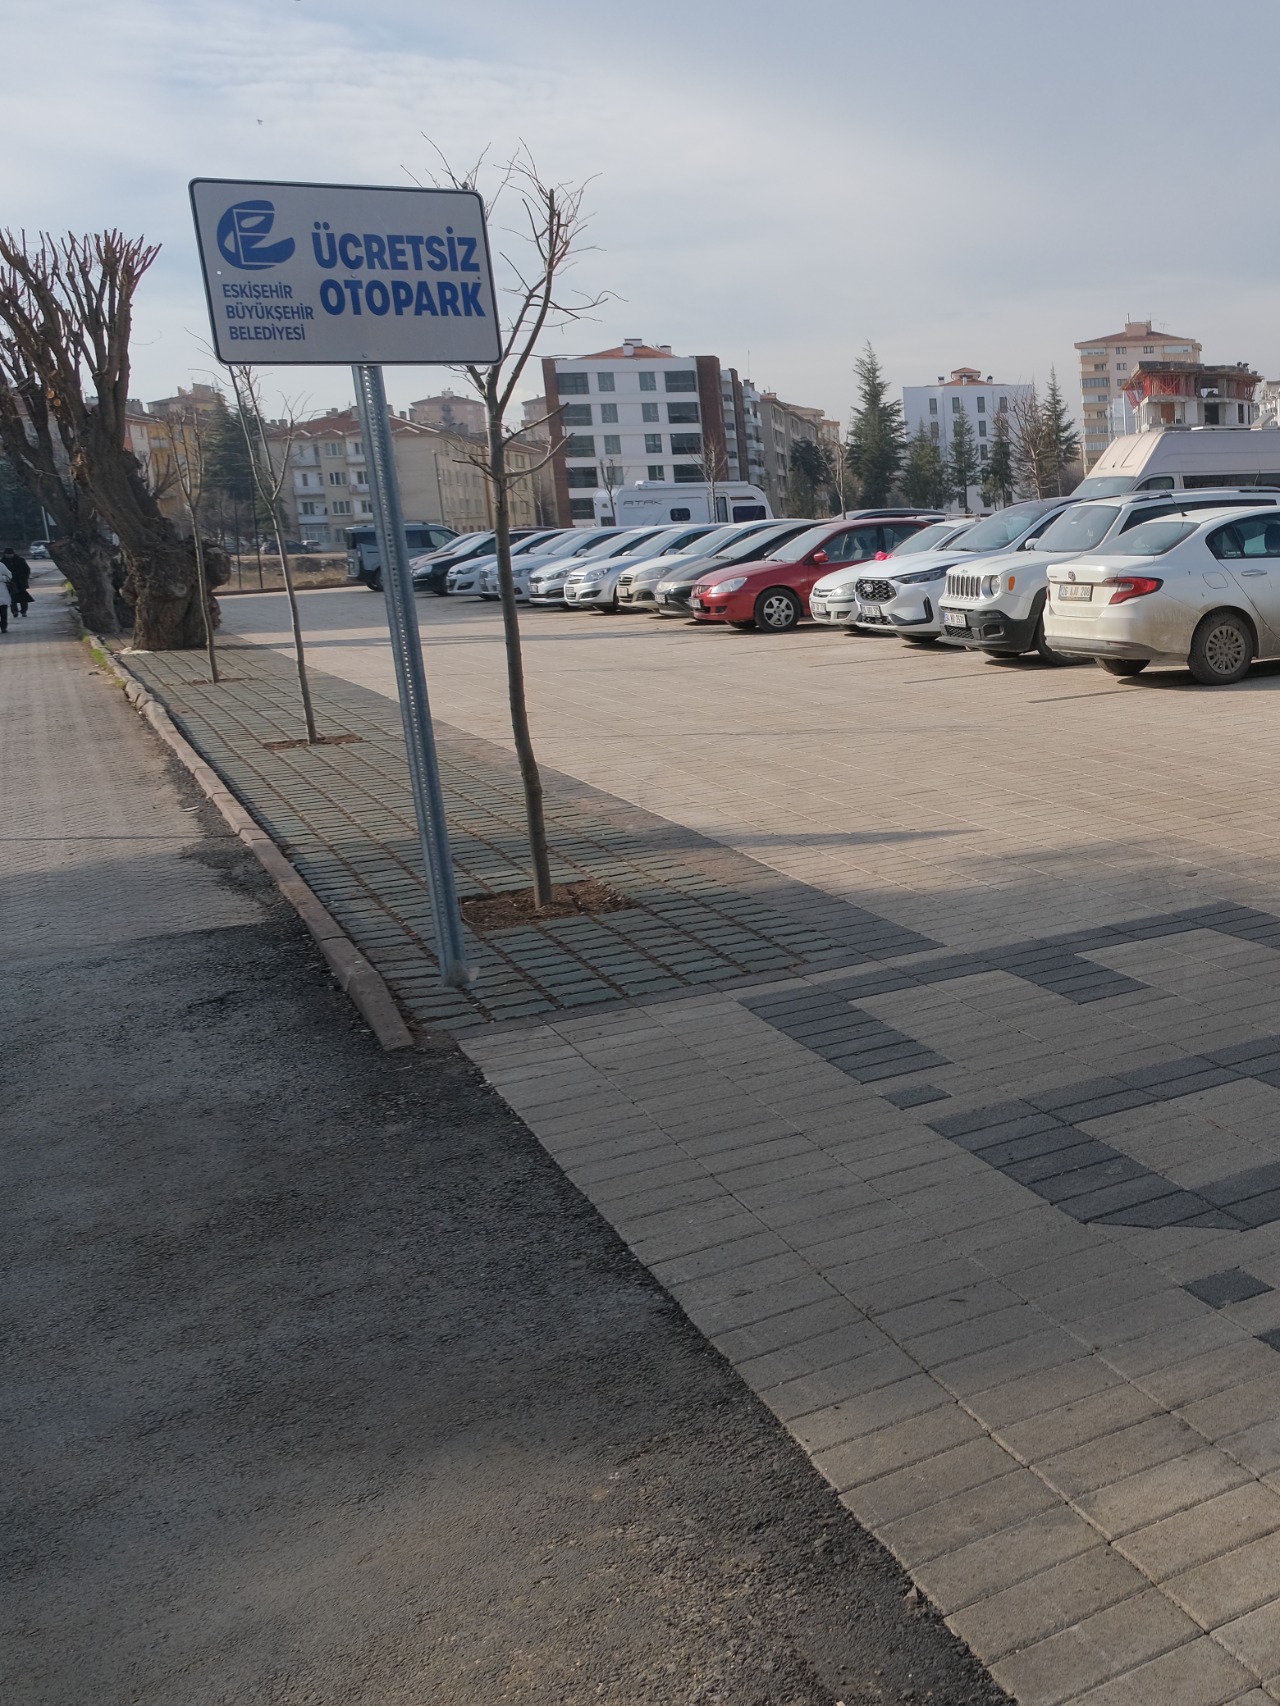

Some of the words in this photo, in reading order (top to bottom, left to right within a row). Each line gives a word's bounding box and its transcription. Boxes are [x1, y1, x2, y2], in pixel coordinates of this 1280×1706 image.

[311, 221, 481, 272] ÜCRETSİZ
[222, 281, 293, 300] ESKİŞEHİR
[320, 278, 486, 318] OTOPARK
[226, 302, 314, 322] BÜYÜKŞEHİR
[230, 324, 306, 341] BELEDİYESİ
